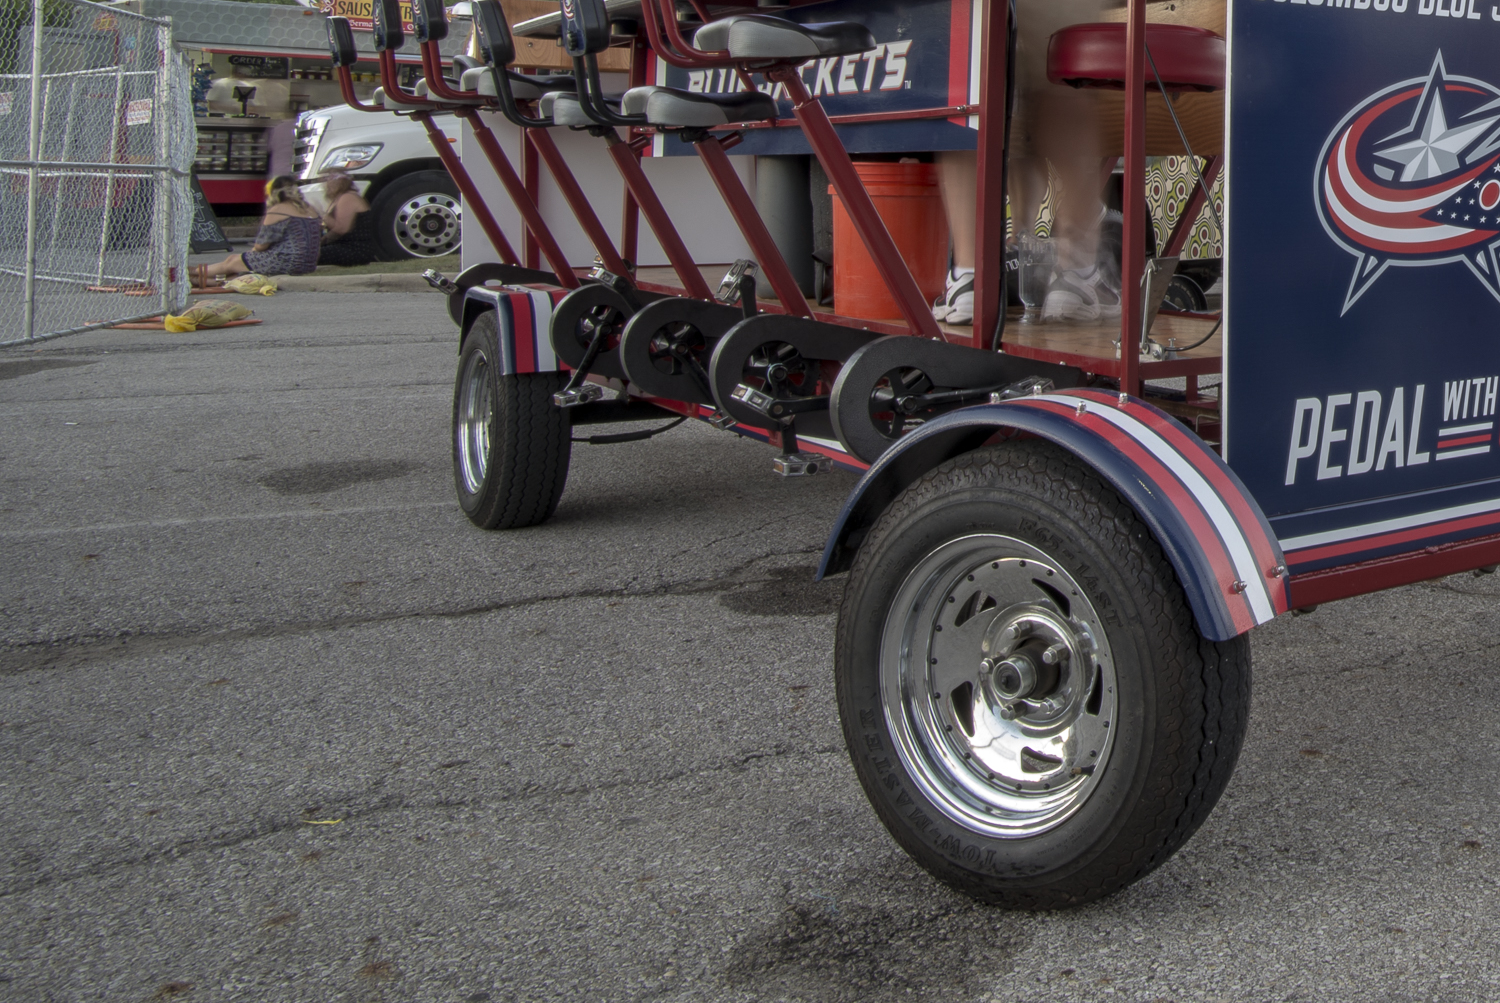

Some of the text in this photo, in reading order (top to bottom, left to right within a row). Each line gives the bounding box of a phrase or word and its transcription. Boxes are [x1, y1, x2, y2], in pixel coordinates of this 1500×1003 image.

[337, 0, 373, 17] SAUS
[1284, 384, 1430, 486] PEDAL
[1443, 375, 1499, 422] WITH
